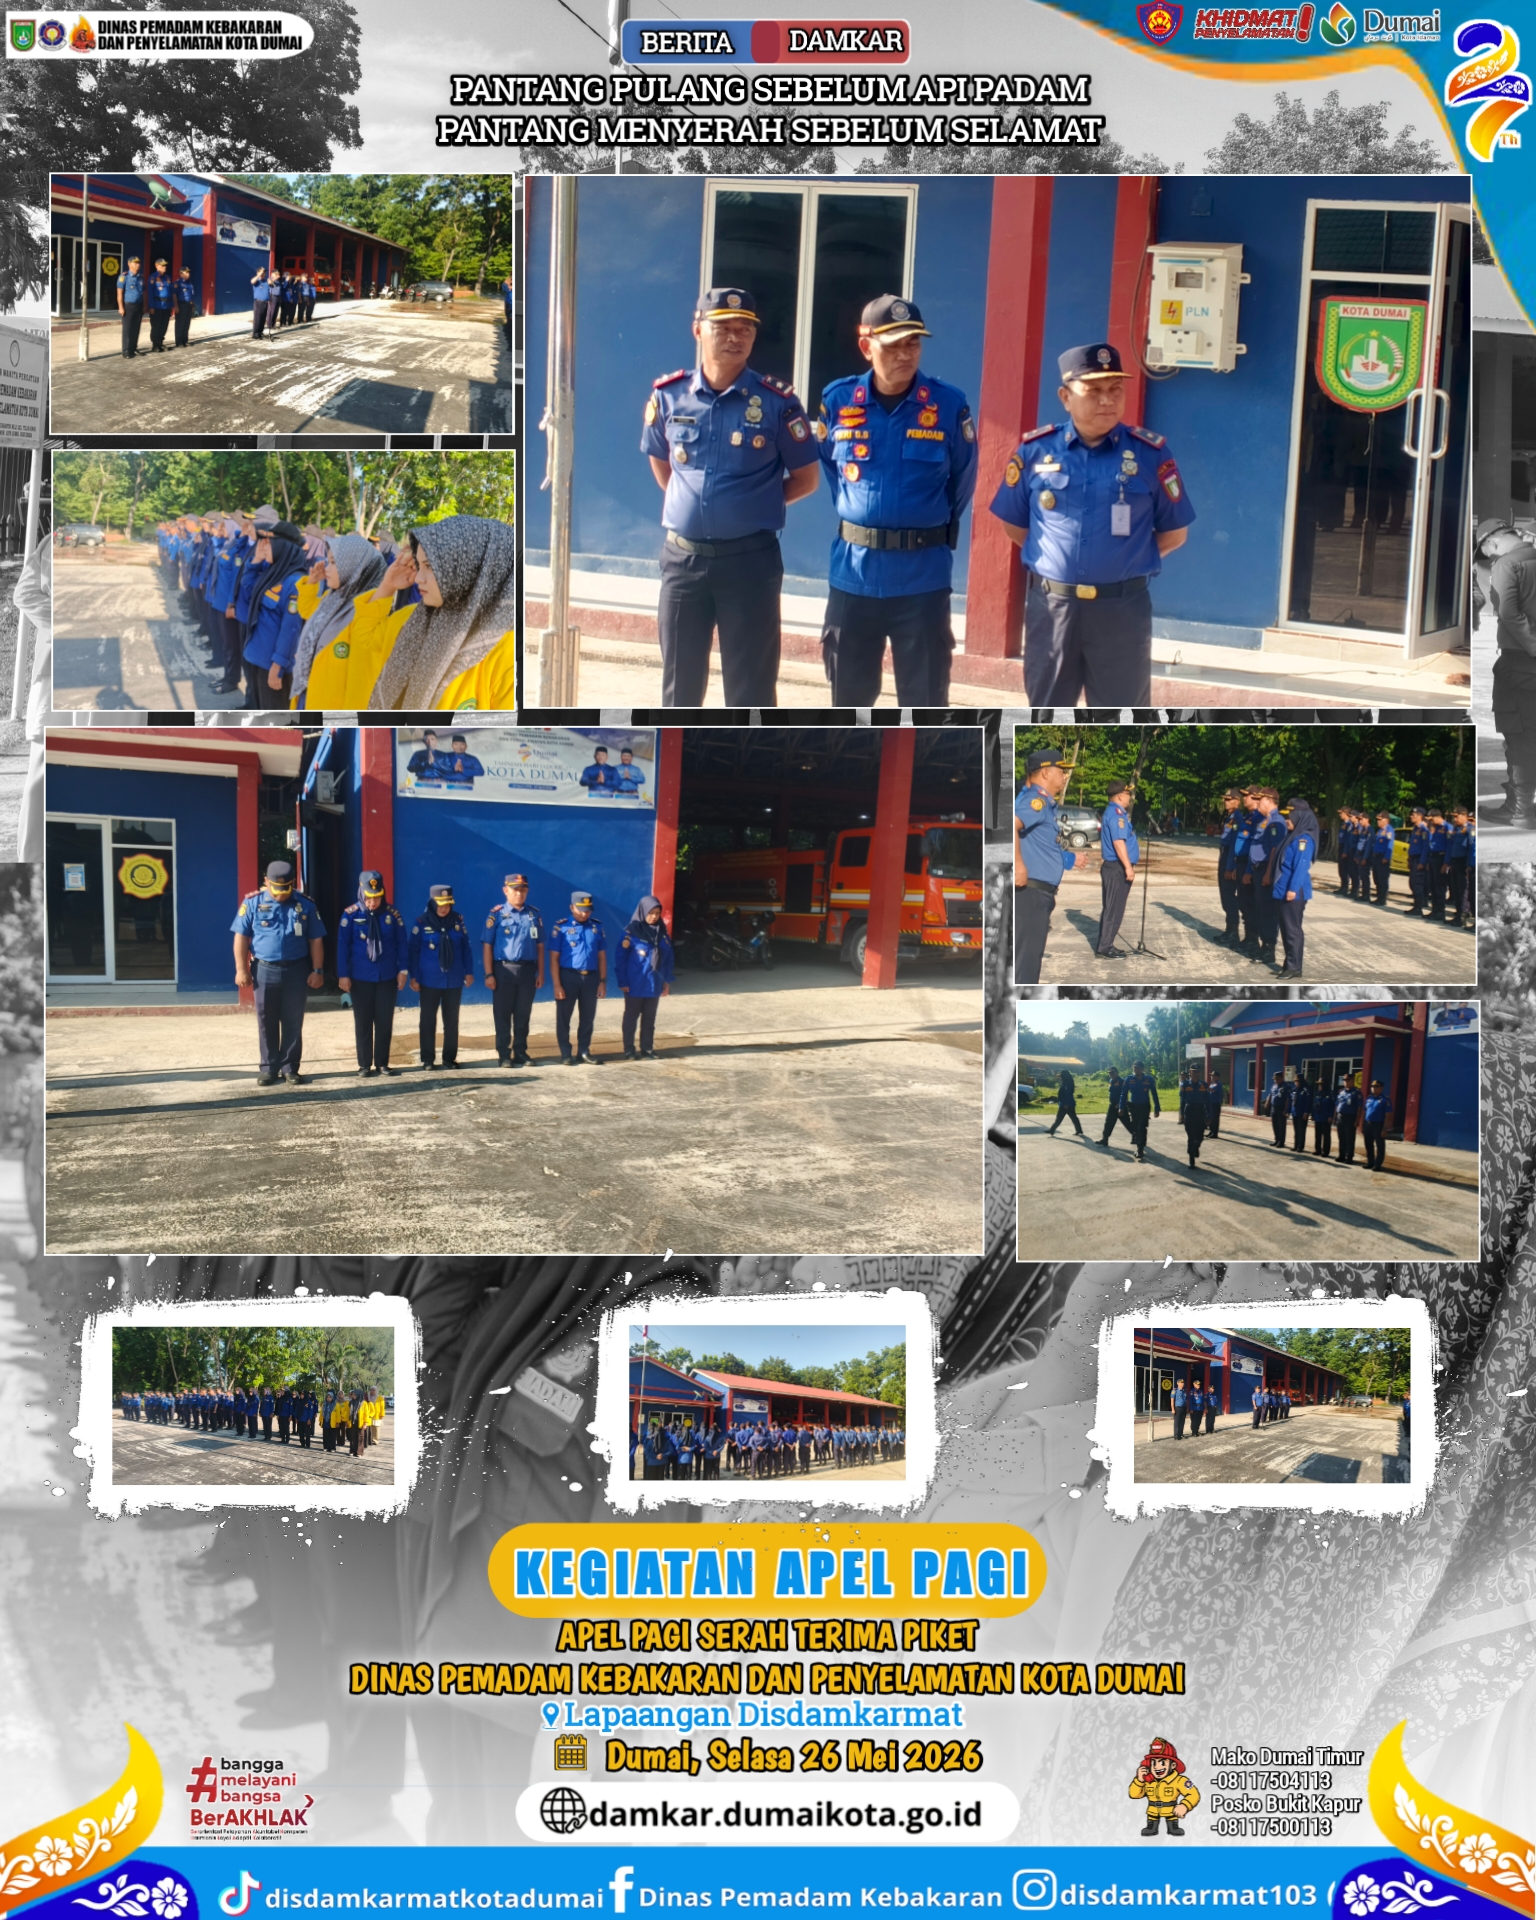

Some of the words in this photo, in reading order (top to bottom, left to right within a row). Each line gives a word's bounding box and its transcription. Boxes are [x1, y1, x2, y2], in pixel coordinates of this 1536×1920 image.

[1185, 306, 1210, 317] PLN
[1342, 305, 1370, 317] KOTA
[1373, 307, 1407, 318] DUMAI
[906, 429, 944, 440] PEMADAM
[487, 766, 525, 778] KOTA
[530, 769, 579, 782] DUMAI
